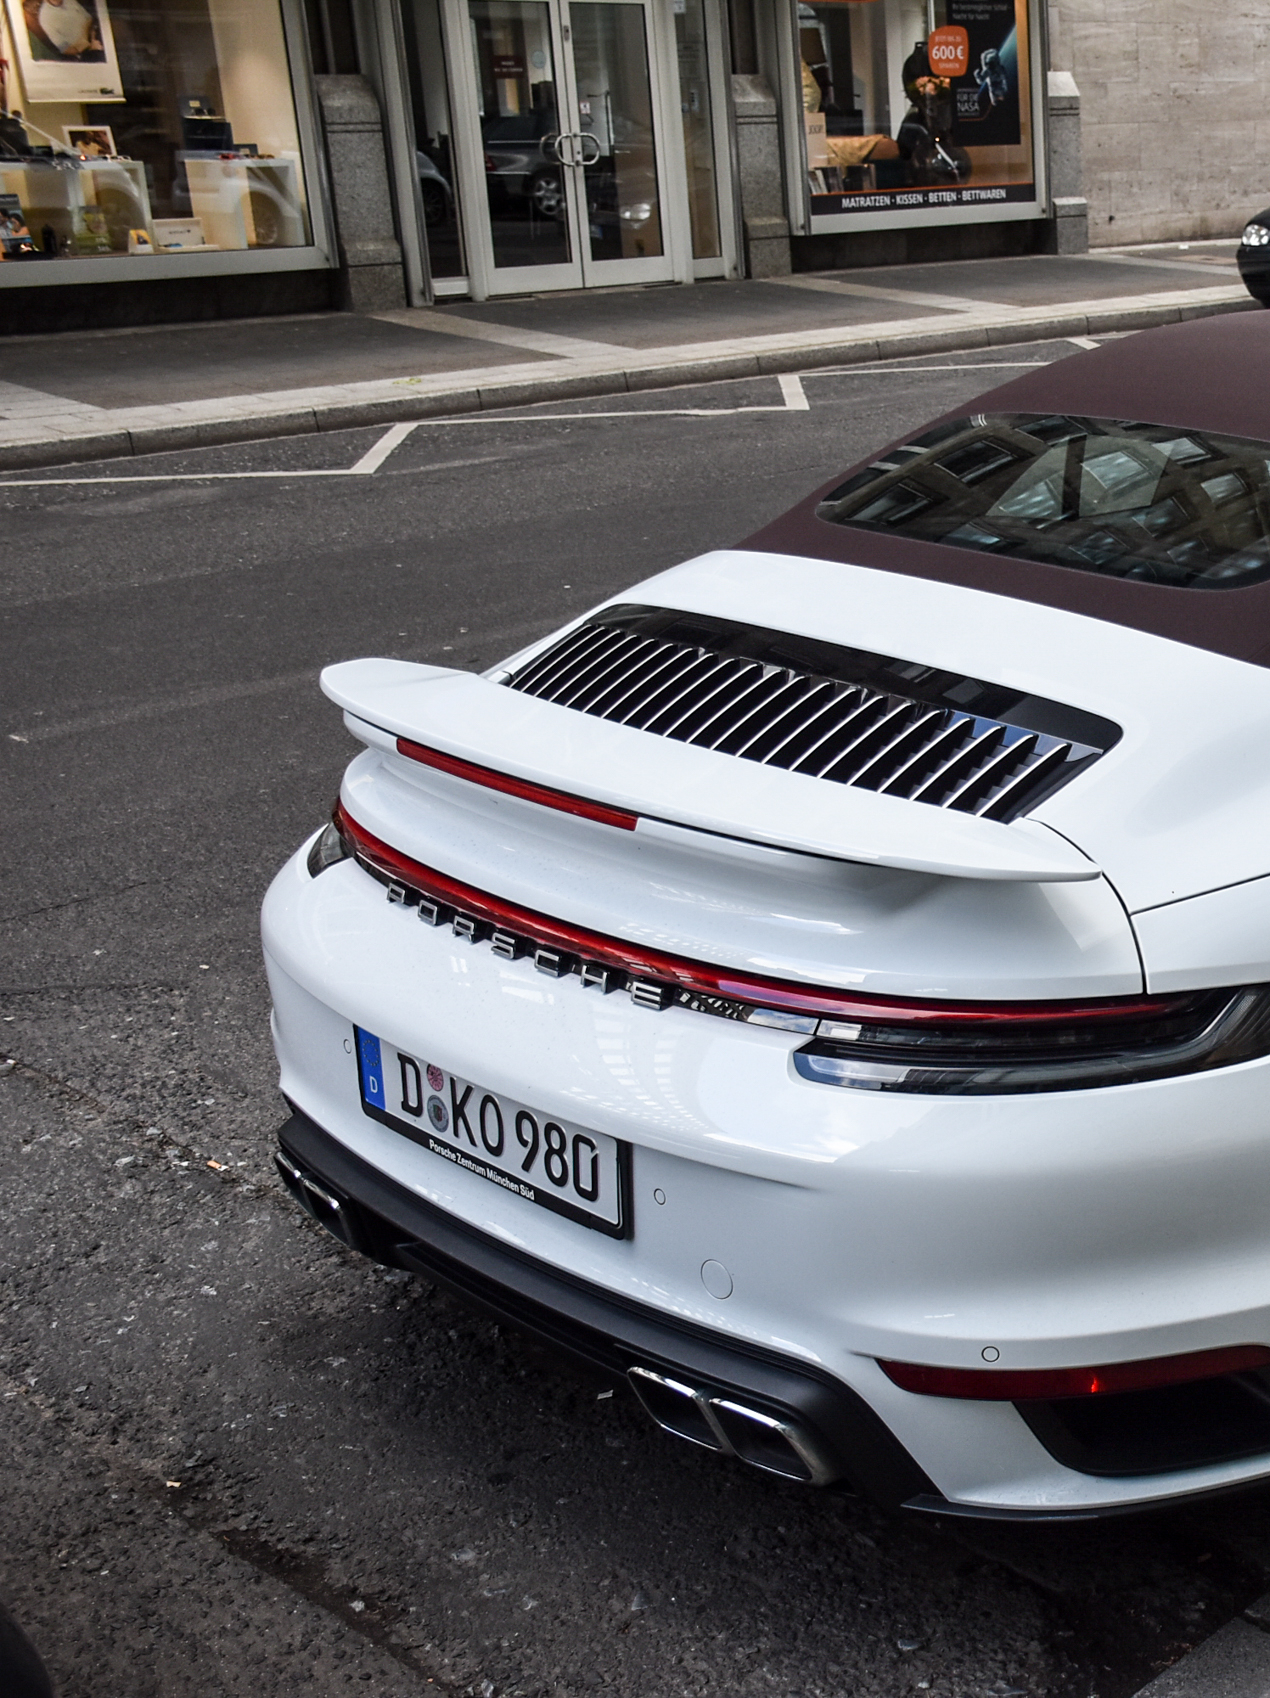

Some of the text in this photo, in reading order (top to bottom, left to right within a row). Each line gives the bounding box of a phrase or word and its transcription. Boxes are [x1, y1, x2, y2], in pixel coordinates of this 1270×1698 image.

[932, 45, 965, 60] 600 €
[957, 101, 980, 112] NASA
[841, 188, 1007, 209] MATRATZEN KISSEN BETTEN BETTWAREN
[387, 882, 663, 1011] PORSCHE
[369, 1052, 600, 1202] D D KO 980
[429, 1138, 535, 1201] Porsche Zentrum München Süd
